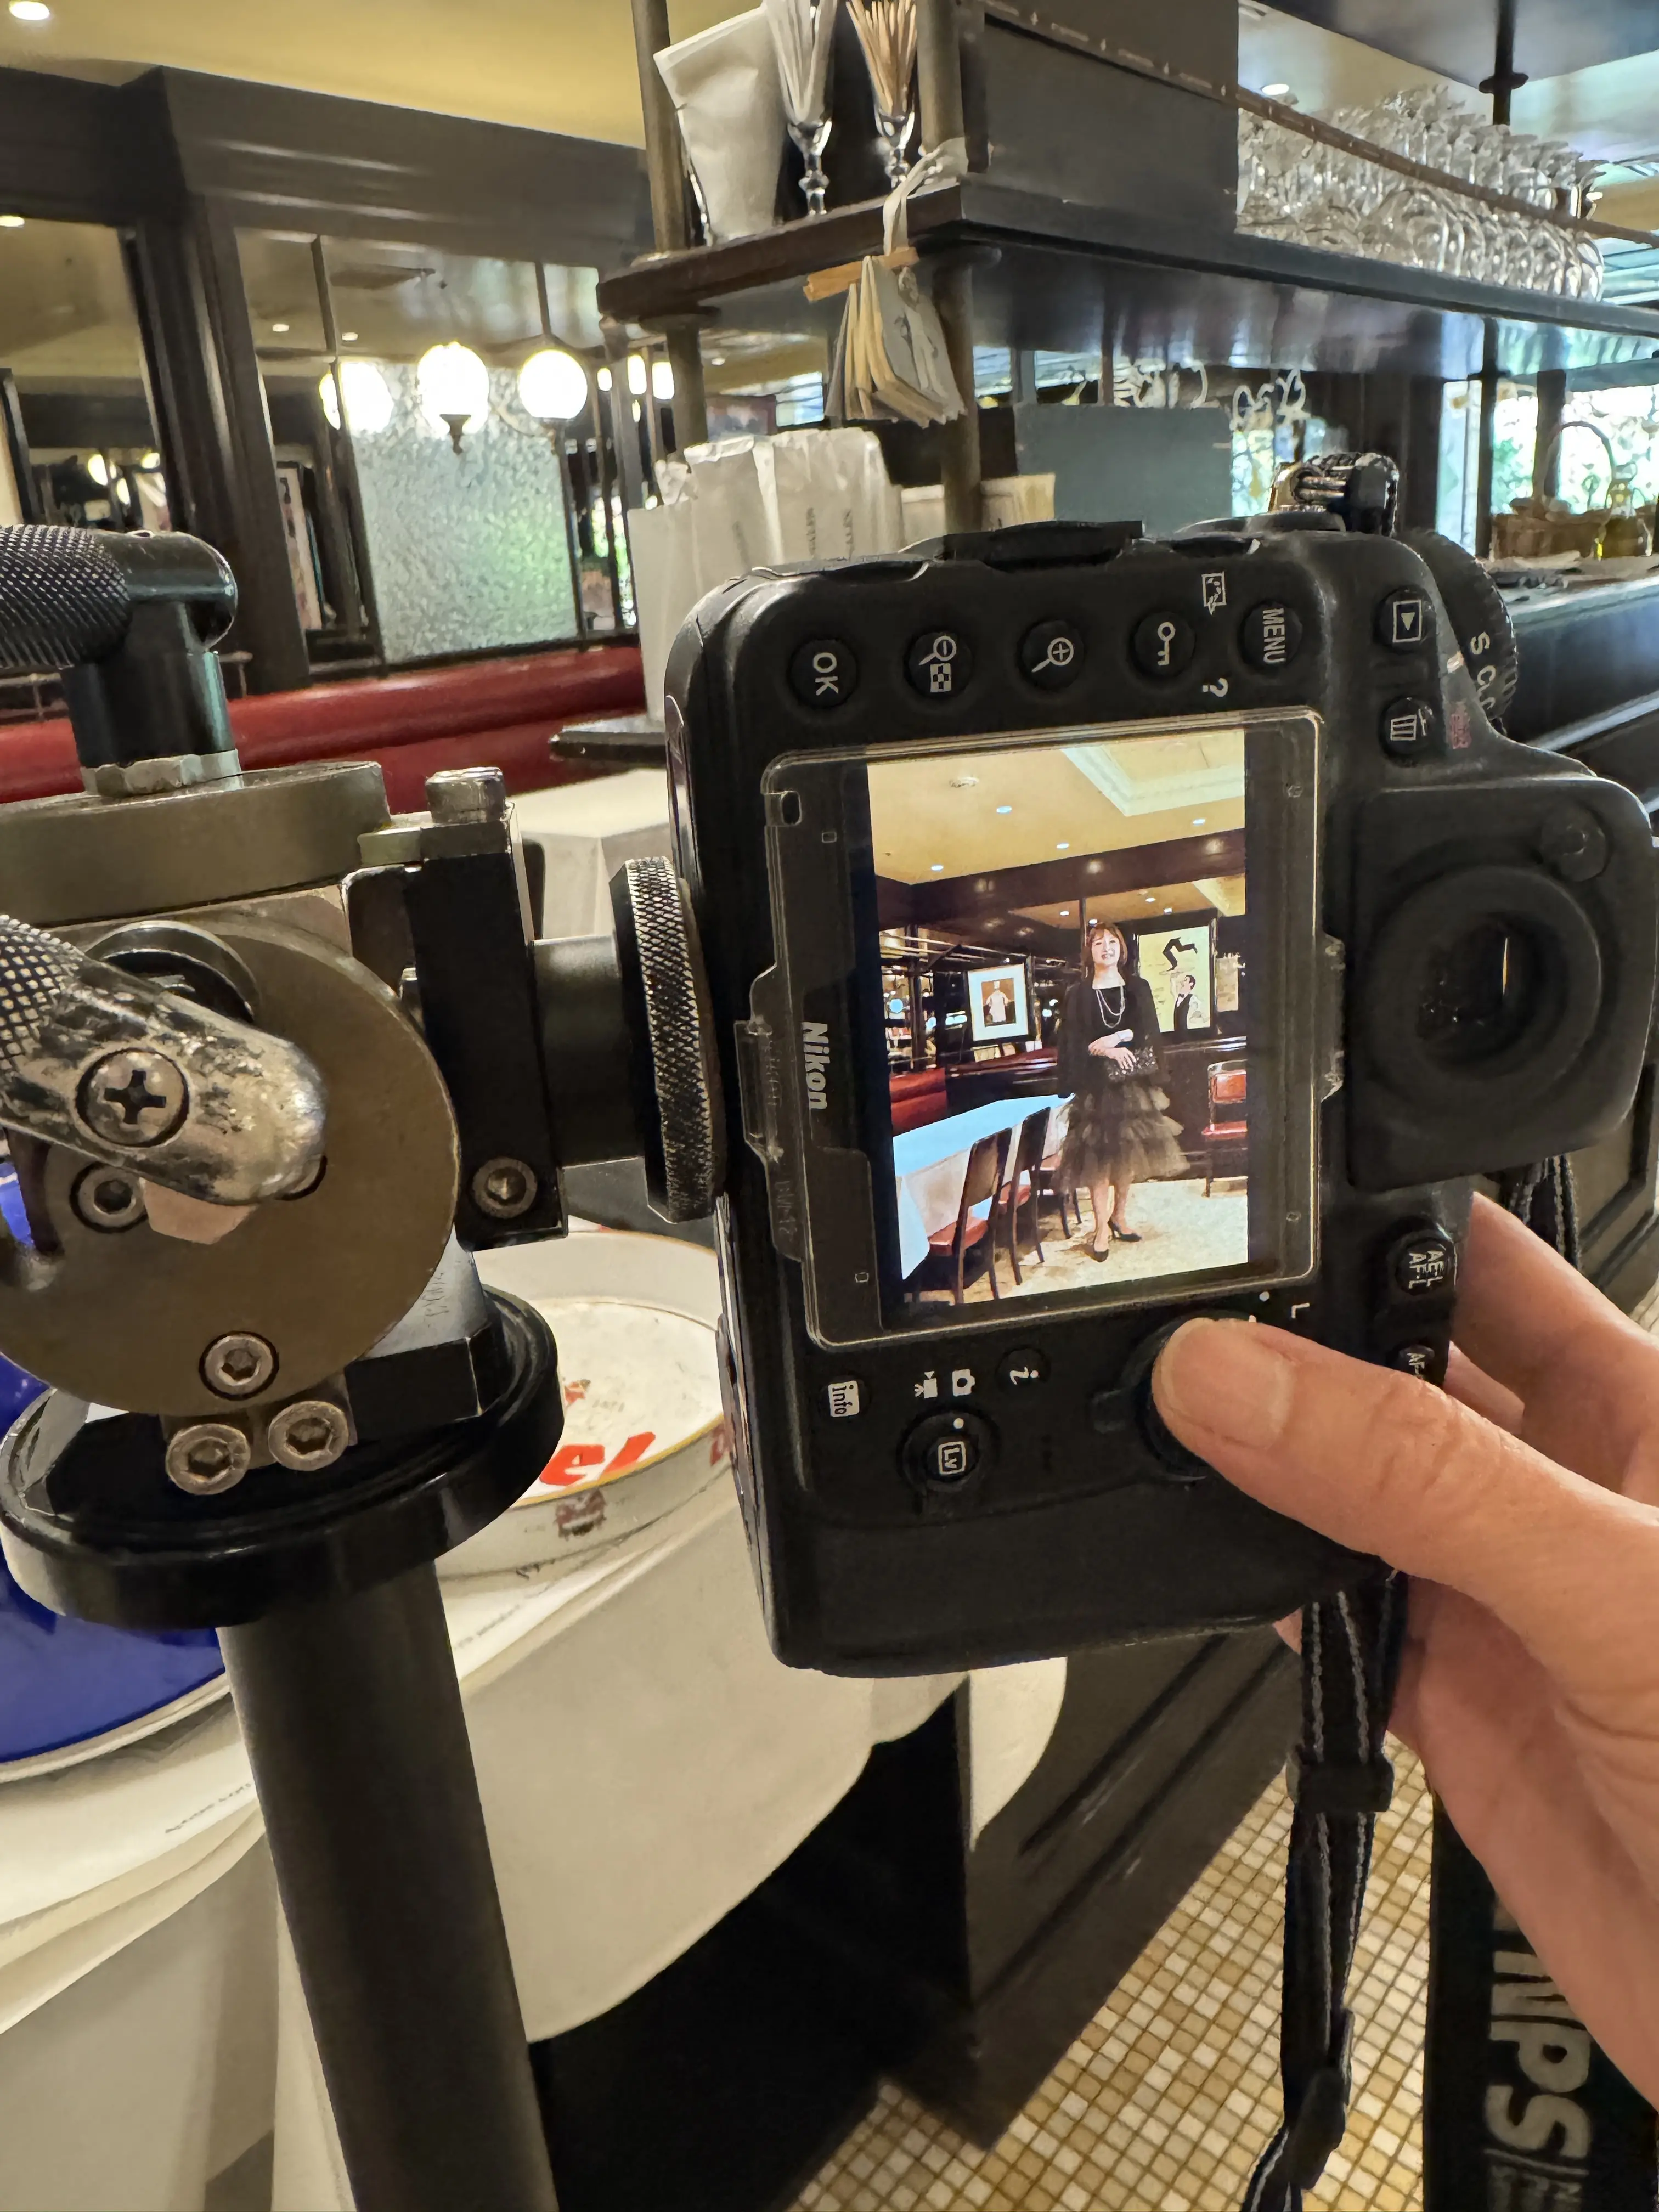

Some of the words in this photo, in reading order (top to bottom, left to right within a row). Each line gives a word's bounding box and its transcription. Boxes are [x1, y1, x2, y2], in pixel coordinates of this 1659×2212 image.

[1262, 607, 1286, 664] MENU
[1470, 631, 1490, 654] S
[812, 652, 839, 696] OK
[802, 1022, 830, 1109] Nikon
[1426, 1250, 1445, 1288] AE-L
[1291, 1302, 1310, 1318] L
[1009, 1366, 1039, 1385] i
[1407, 1352, 1427, 1377] AF-
[831, 1383, 855, 1416] info
